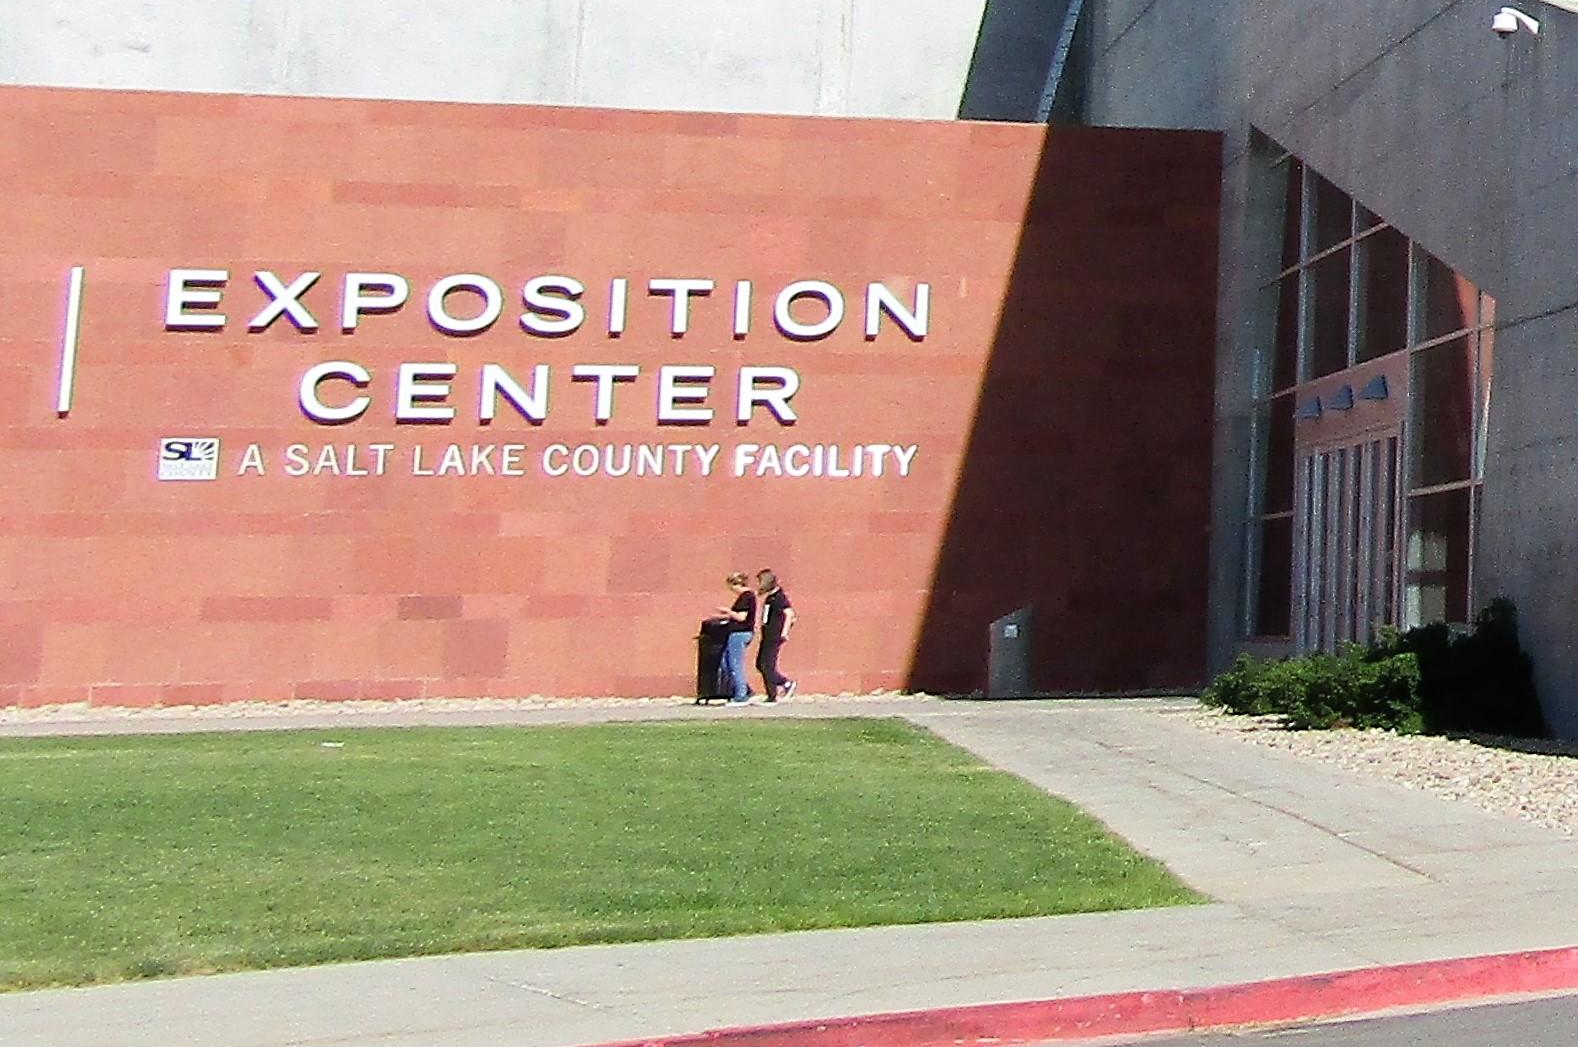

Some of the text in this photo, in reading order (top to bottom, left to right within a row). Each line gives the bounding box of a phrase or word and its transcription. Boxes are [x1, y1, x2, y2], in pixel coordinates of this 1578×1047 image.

[164, 268, 932, 339] EXPOSITION
[298, 360, 801, 424] CENTER
[237, 443, 265, 476] A
[283, 443, 395, 476] SALT
[411, 443, 525, 476] LAKE
[542, 443, 720, 477] COUNTY
[732, 443, 918, 478] FACILITY
